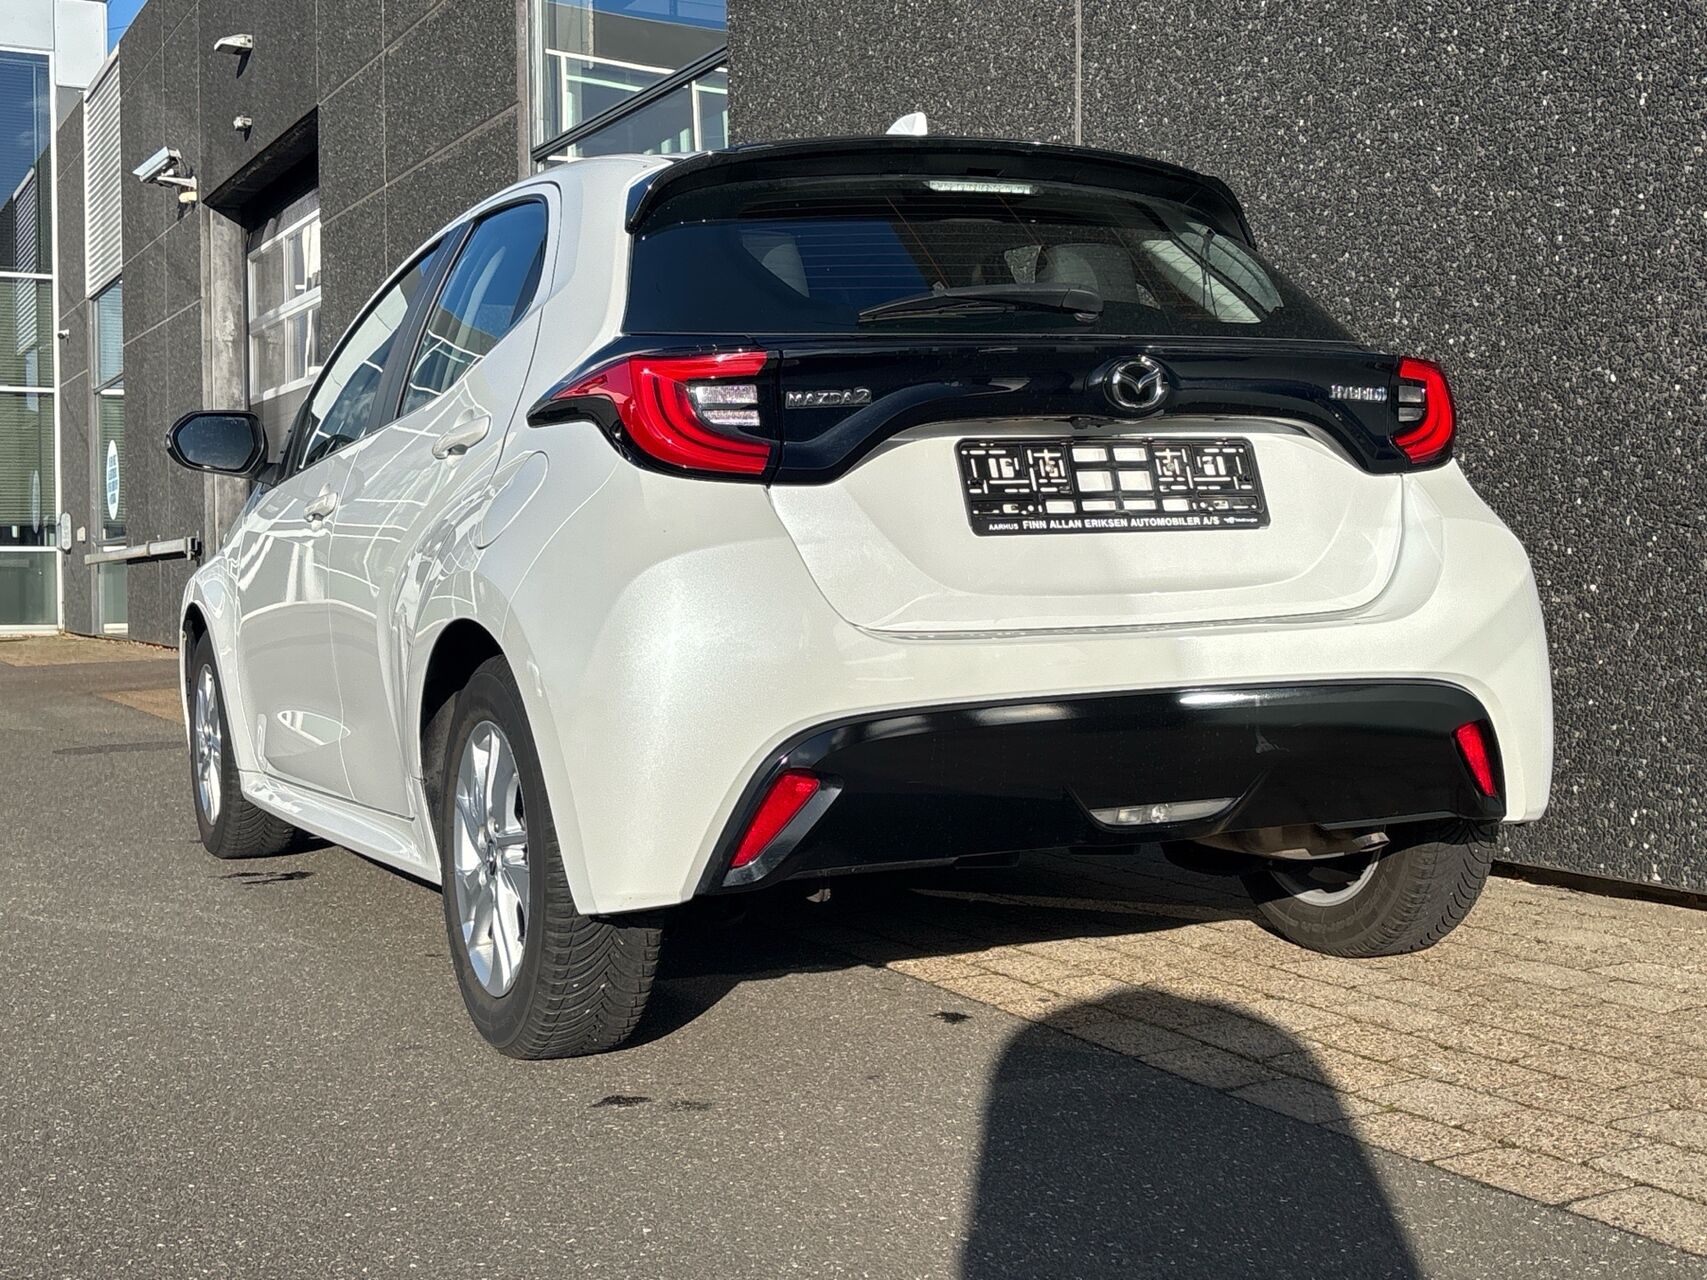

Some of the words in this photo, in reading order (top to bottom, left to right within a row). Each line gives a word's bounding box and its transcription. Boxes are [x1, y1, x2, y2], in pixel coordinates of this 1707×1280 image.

[785, 387, 872, 408] MAZDA2
[1329, 384, 1388, 402] HYBRID
[988, 523, 1019, 531] AARHUS
[1022, 519, 1048, 530] FINN
[1049, 519, 1083, 529] ALLAN
[1084, 517, 1129, 528] ERIKSEN
[1130, 516, 1201, 528] AUTOMOBILER
[1202, 515, 1221, 526] A/S
